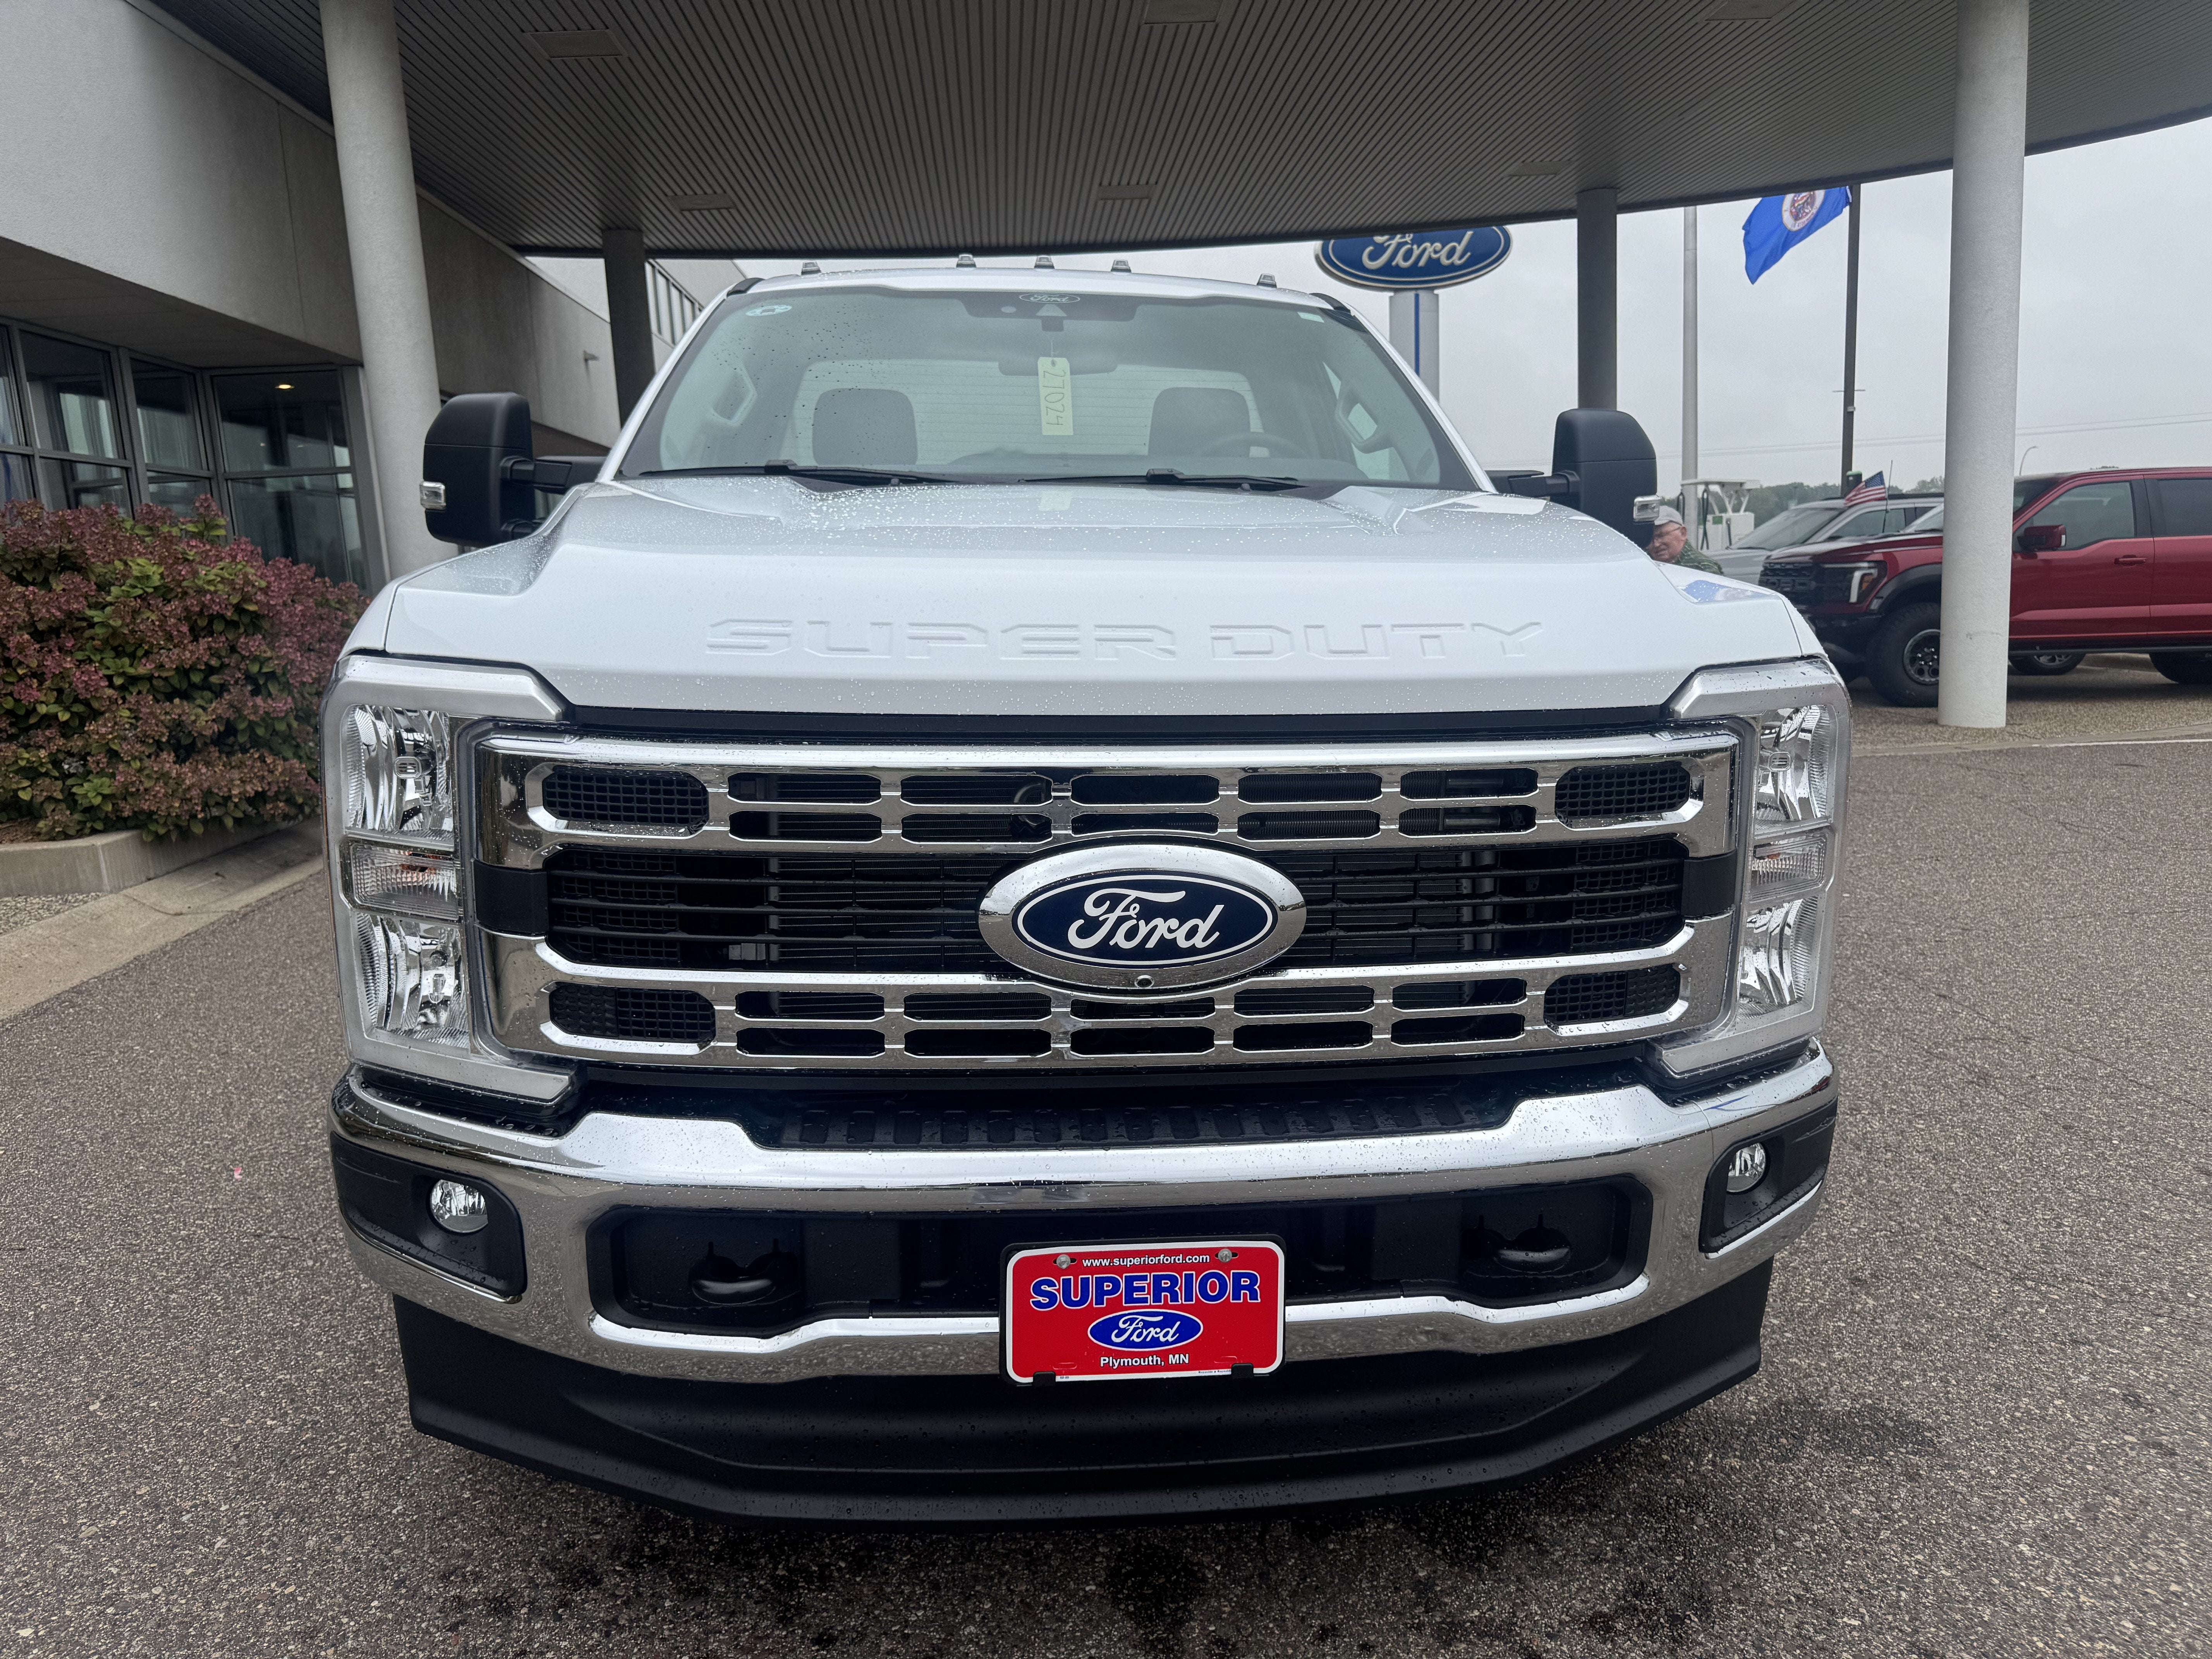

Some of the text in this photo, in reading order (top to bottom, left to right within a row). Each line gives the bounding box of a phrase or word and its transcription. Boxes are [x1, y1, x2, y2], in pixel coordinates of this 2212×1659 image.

[1362, 231, 1474, 270] Ford
[1042, 369, 1066, 426] 27024
[706, 618, 1544, 660] SUPER DUTY
[1067, 888, 1224, 949] Ford
[1082, 1254, 1210, 1267] www.superiorford.com
[1030, 1270, 1261, 1311] SUPERIOR
[1111, 1315, 1181, 1343] Ford
[1100, 1353, 1189, 1369] Plymouth, MN
